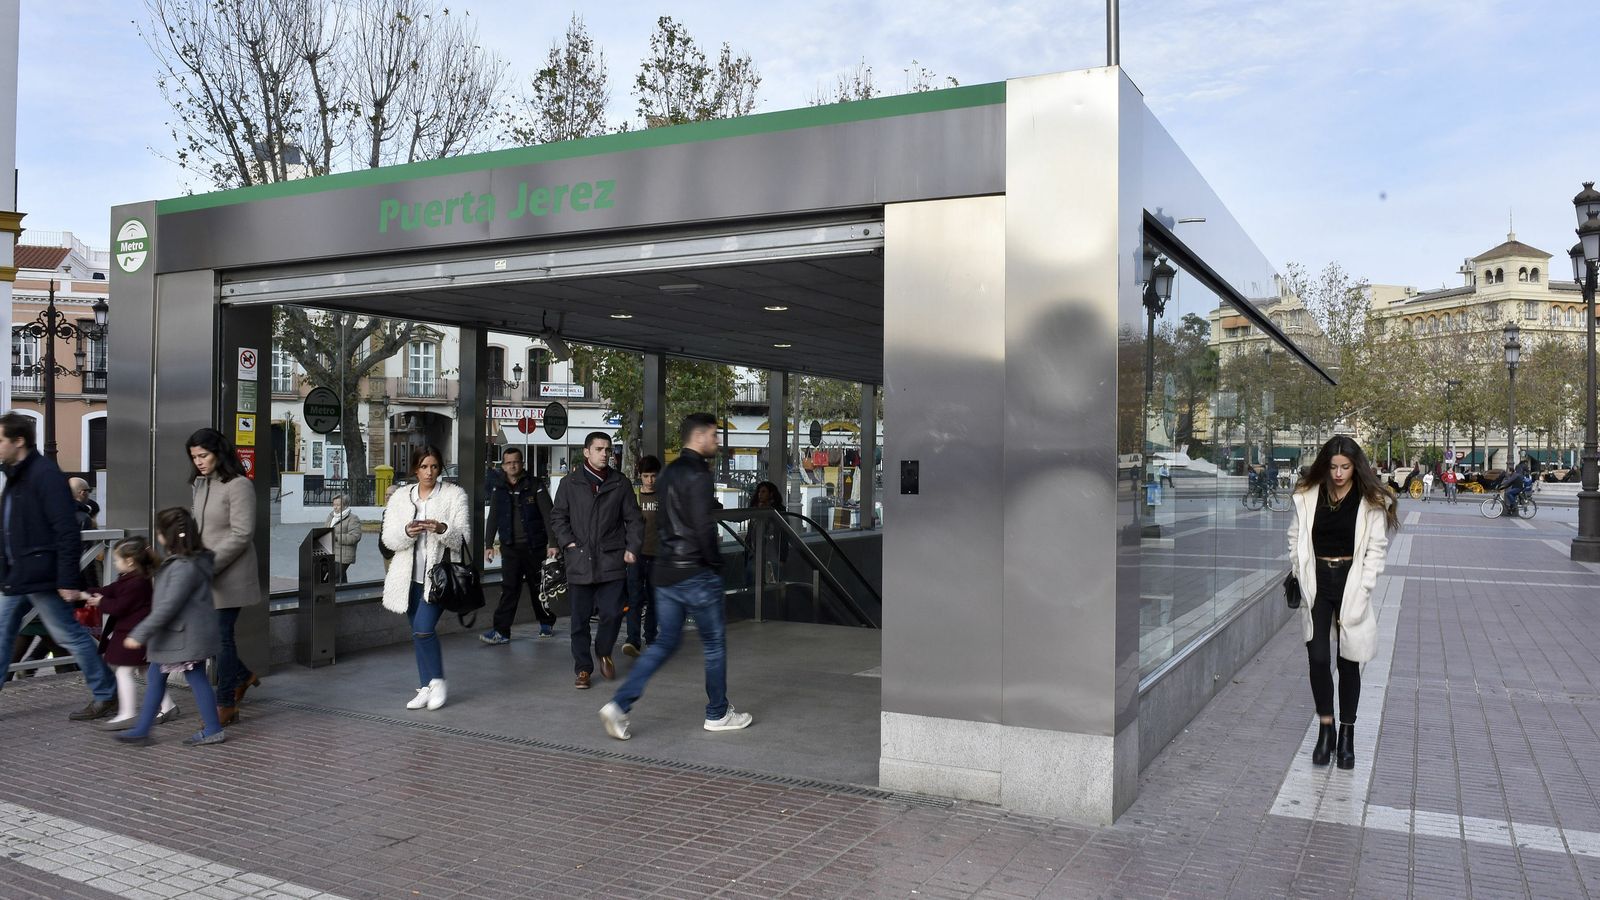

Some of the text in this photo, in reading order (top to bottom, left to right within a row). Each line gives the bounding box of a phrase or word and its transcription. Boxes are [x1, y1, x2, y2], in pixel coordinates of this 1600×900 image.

[378, 179, 616, 234] Puerta Jerez
[121, 241, 143, 252] Metro
[310, 405, 335, 415] Metro
